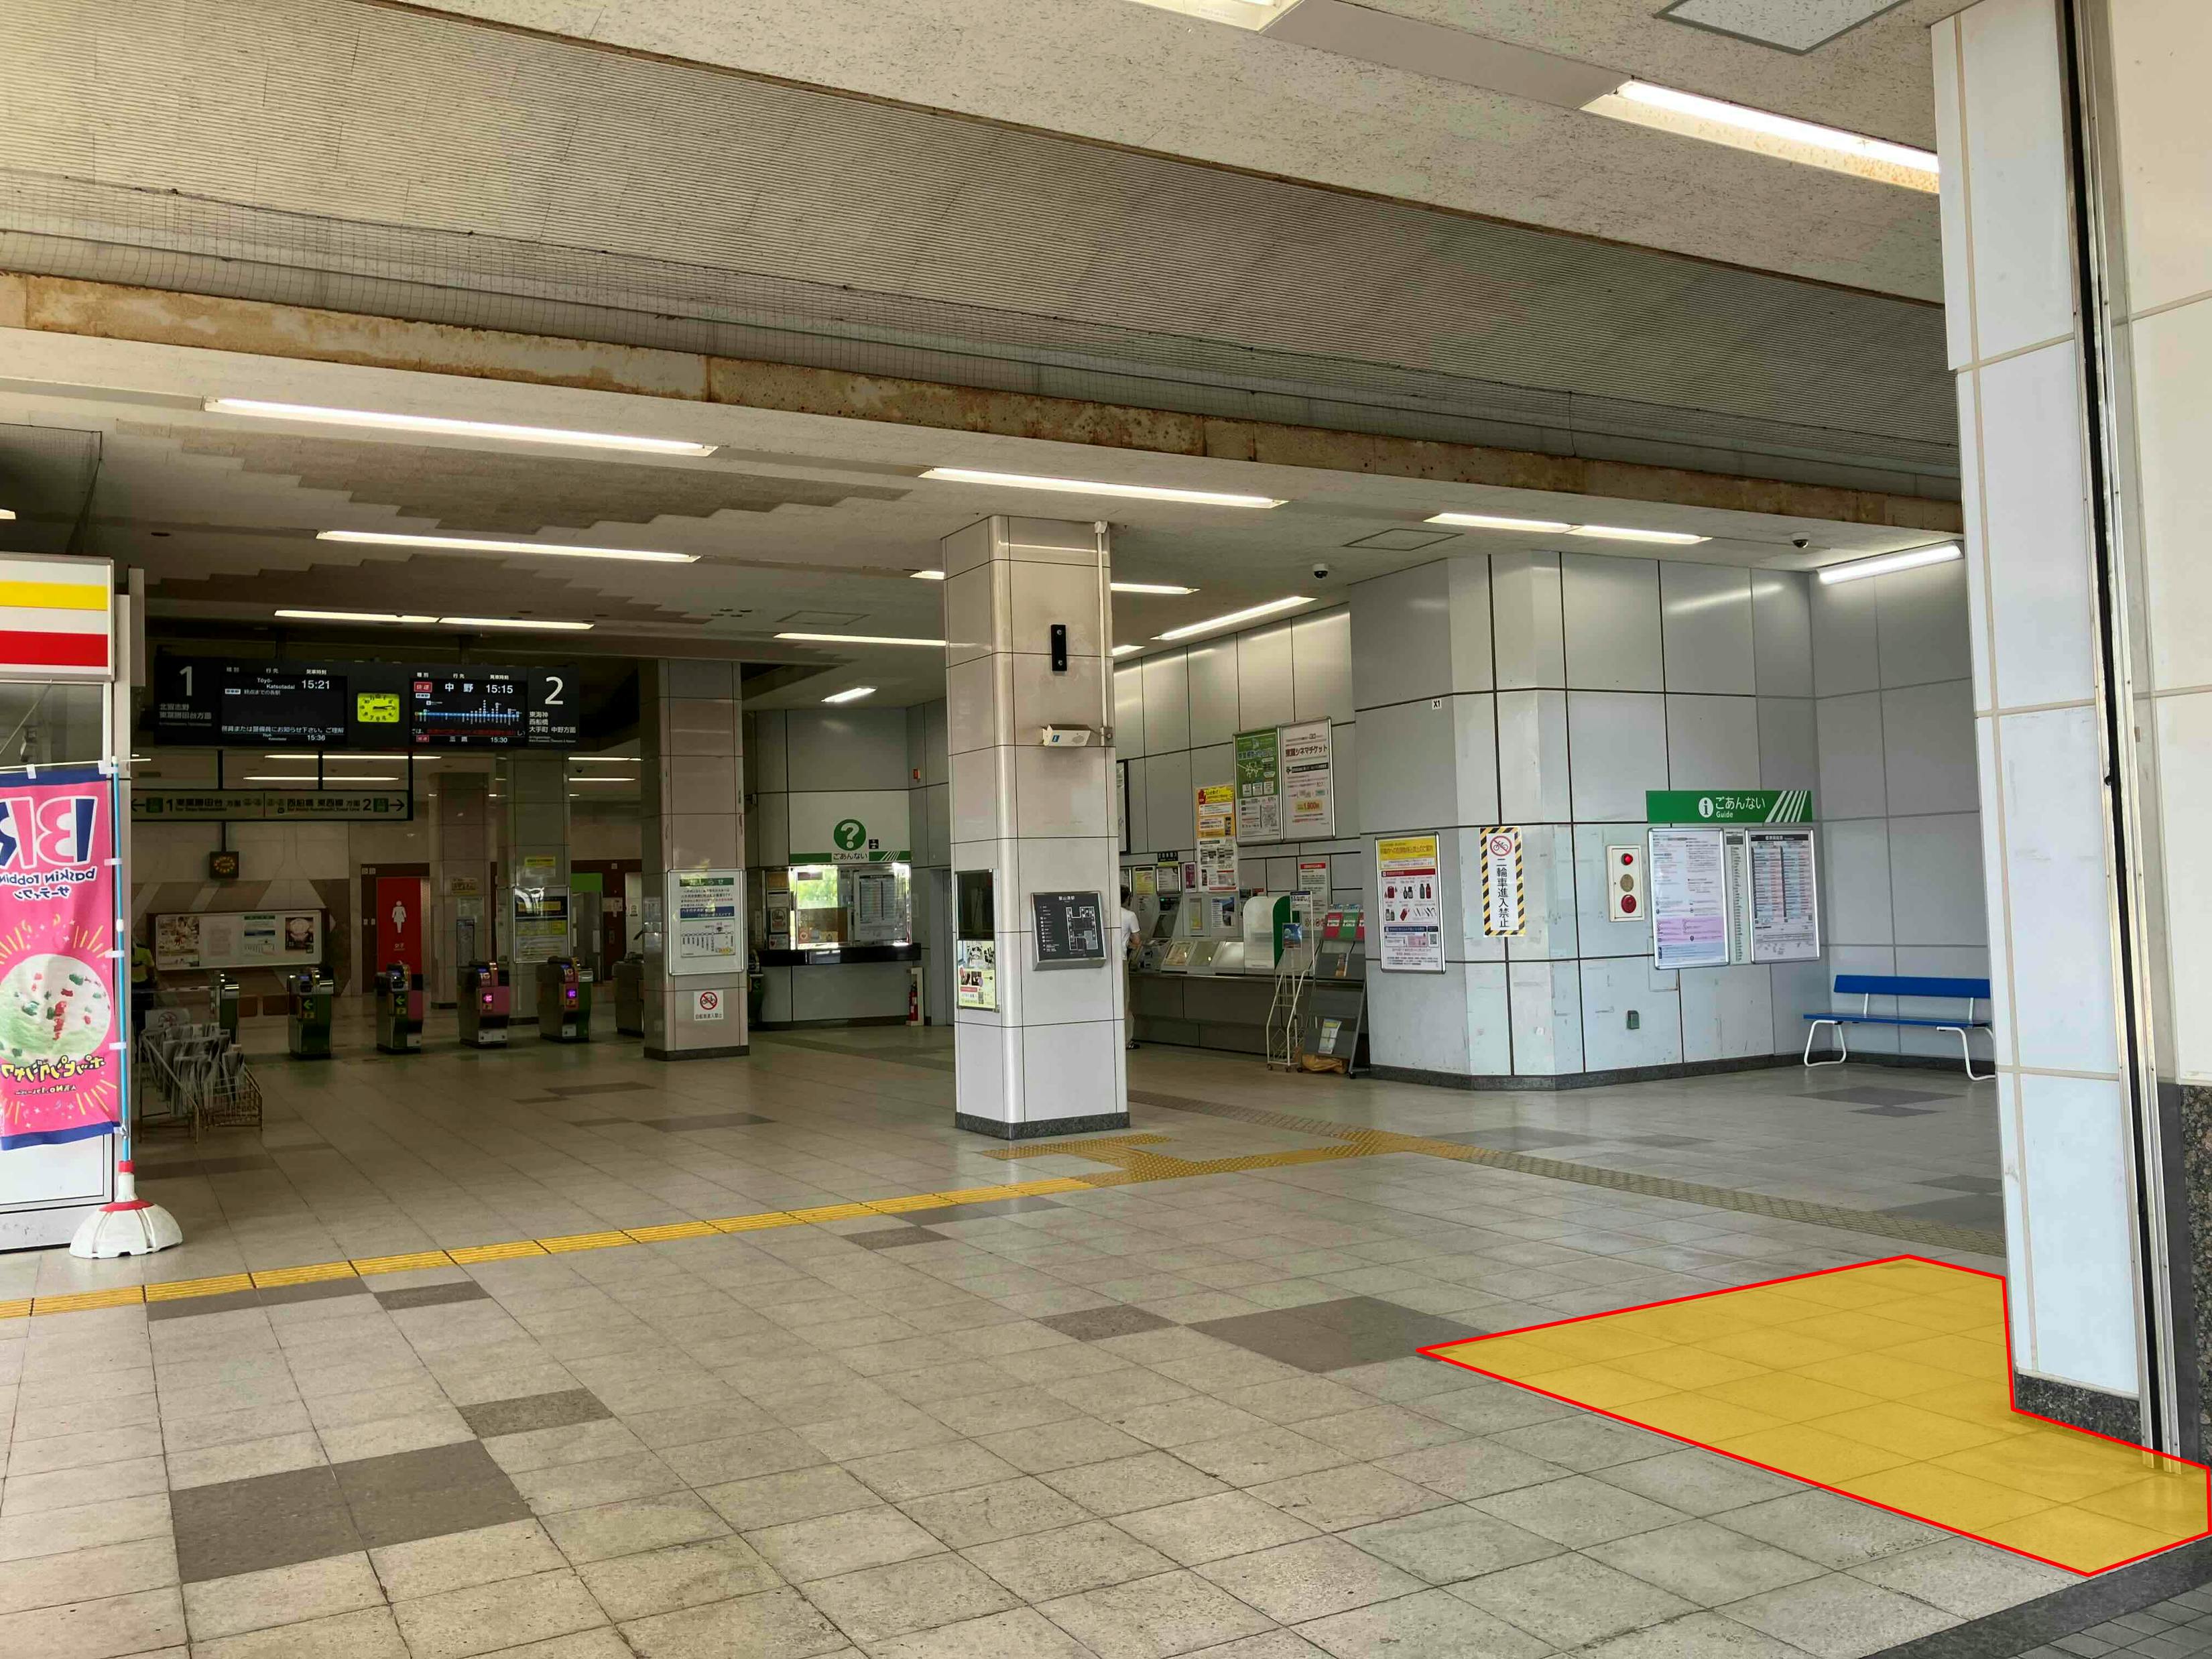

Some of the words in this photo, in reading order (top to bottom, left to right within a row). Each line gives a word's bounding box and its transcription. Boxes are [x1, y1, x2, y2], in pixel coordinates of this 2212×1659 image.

[179, 666, 192, 696] 1
[302, 680, 330, 690] 15:21
[486, 684, 513, 694] 15:15
[545, 676, 564, 704] 2
[166, 799, 173, 811] 1
[363, 799, 371, 810] 2
[1715, 796, 1766, 810] ごあんない
[833, 852, 867, 861] ごあんない
[1495, 858, 1510, 928] 二輪車進入禁止
